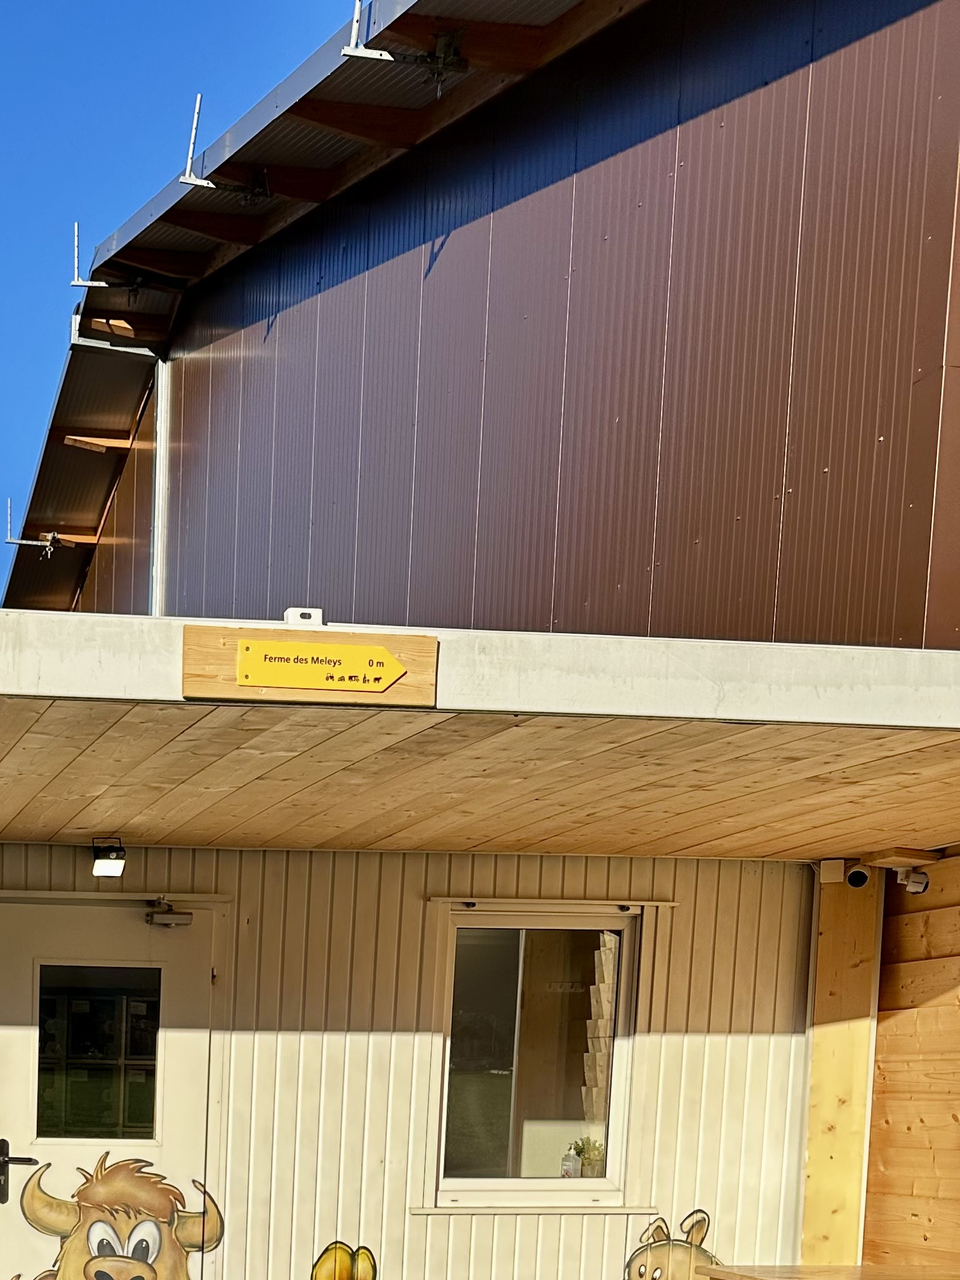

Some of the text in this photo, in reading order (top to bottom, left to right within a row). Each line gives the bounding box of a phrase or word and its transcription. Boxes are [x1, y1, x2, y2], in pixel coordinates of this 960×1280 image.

[264, 654, 291, 663] Ferme
[293, 655, 308, 665] des
[311, 656, 342, 667] Meleys
[368, 659, 374, 667] 0
